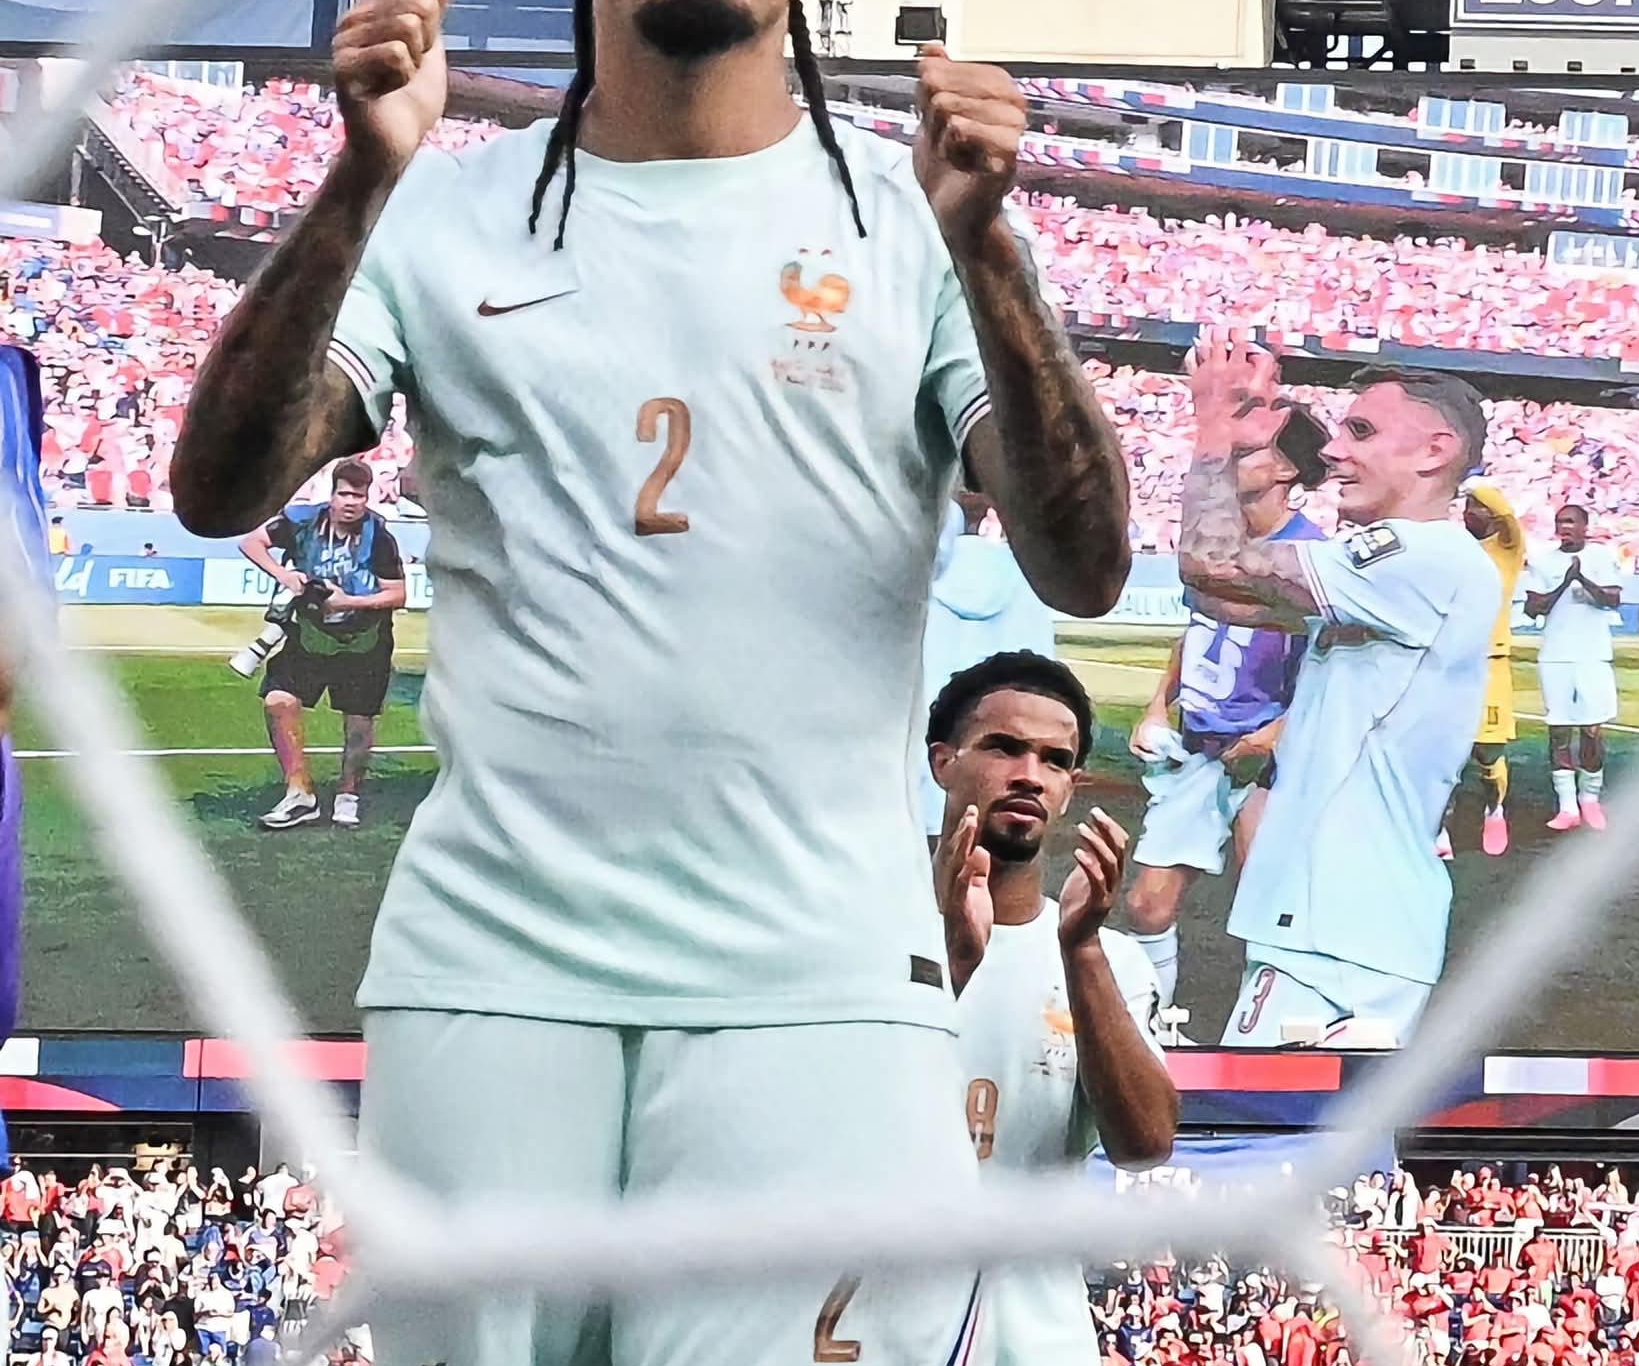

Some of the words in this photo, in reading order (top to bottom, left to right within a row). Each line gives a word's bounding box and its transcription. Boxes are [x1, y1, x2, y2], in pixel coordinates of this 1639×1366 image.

[634, 396, 692, 536] 2
[108, 567, 174, 590] FIFA
[1238, 968, 1277, 1035] 3
